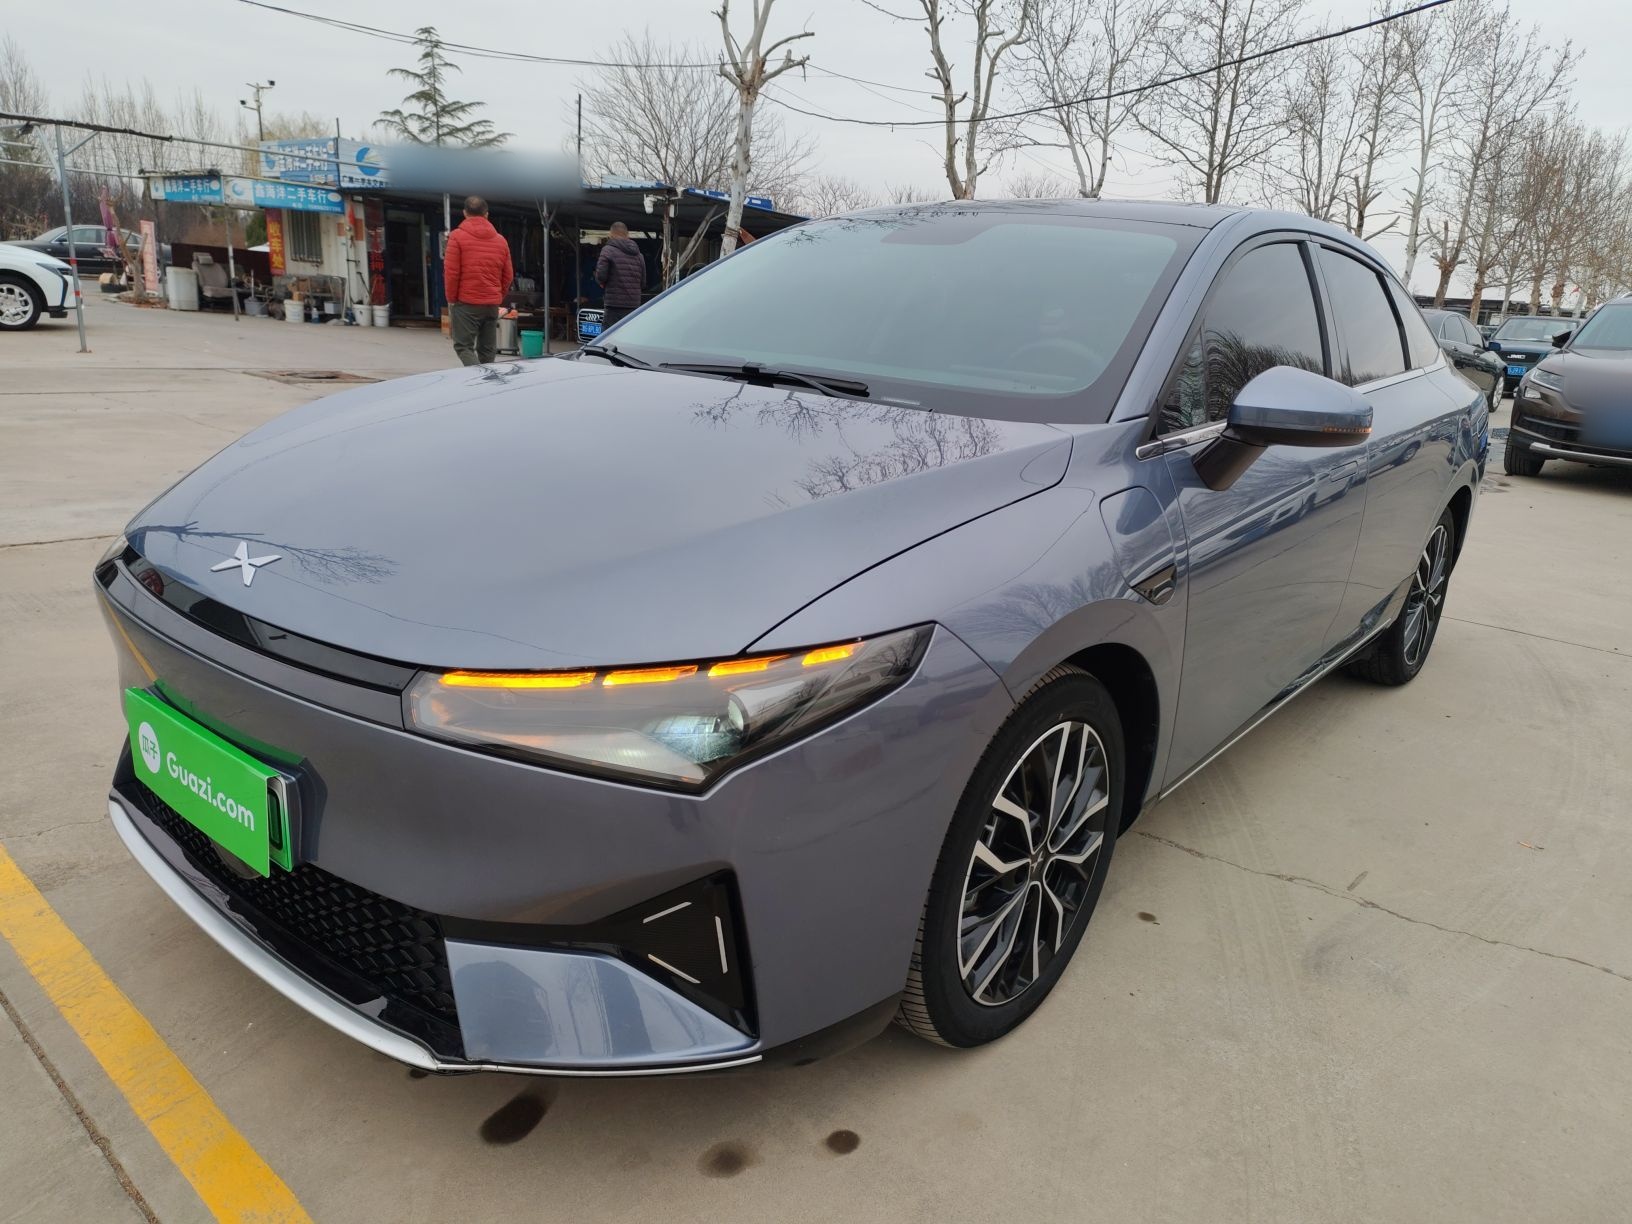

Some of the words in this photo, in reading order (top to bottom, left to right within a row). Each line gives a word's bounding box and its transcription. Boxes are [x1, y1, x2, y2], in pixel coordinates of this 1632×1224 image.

[255, 184, 327, 204] 鑫海洋二手车行
[269, 222, 284, 269] 收车处
[142, 734, 158, 760] 瓜子
[166, 751, 255, 832] Guazi.com
